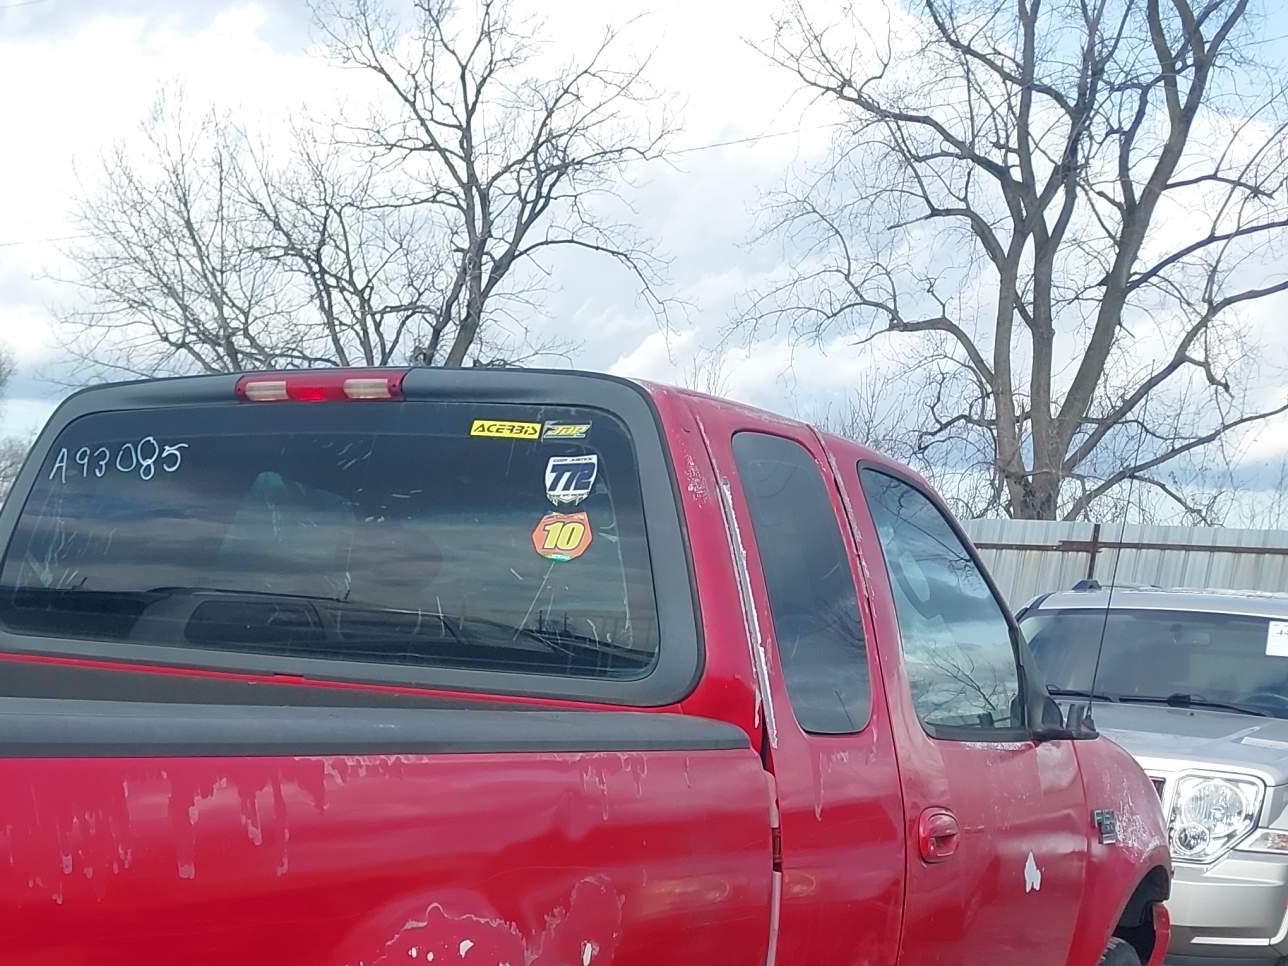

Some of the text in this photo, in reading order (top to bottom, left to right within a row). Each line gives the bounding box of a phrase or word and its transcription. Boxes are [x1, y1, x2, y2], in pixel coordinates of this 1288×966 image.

[473, 422, 538, 436] ACERBIS
[48, 436, 189, 484] A93085
[542, 521, 586, 551] 10
